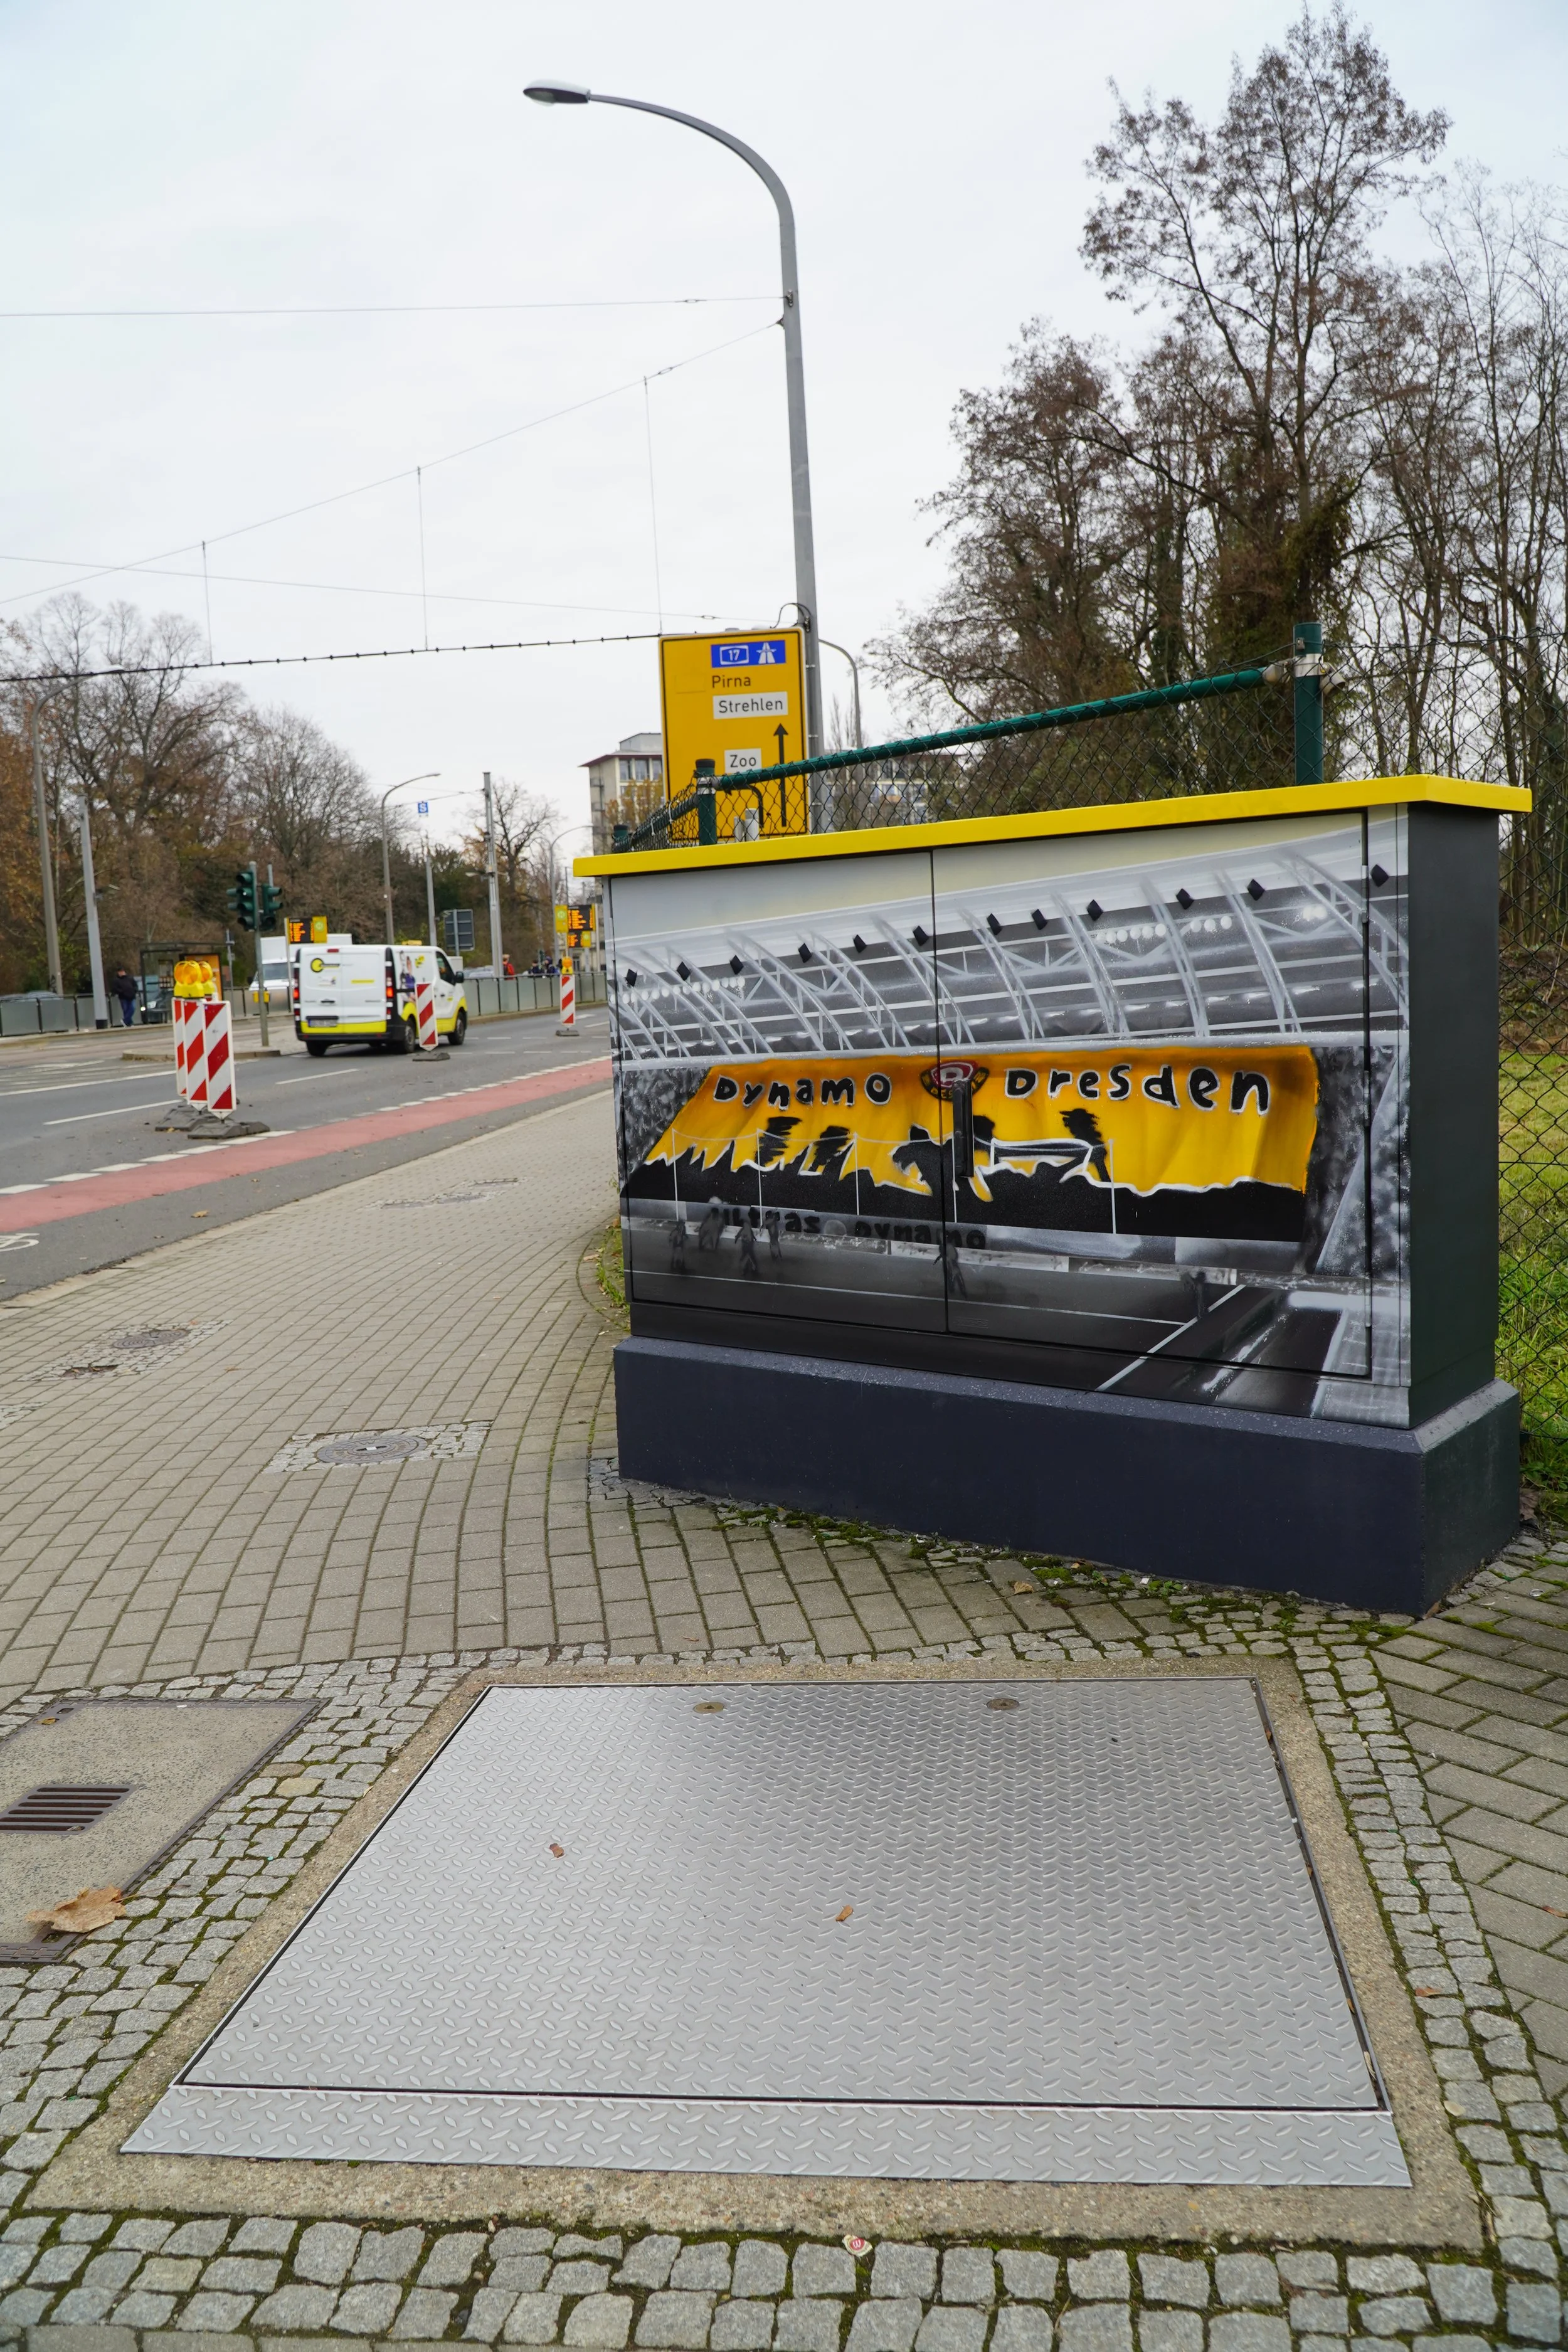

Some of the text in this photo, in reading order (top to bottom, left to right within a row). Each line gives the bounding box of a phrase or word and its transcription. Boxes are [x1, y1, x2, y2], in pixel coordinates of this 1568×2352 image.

[728, 649, 740, 662] 17
[712, 675, 751, 689] Pirna
[719, 698, 783, 714] Strehlen
[729, 755, 757, 768] Zoo
[419, 803, 427, 813] S
[1004, 1062, 1271, 1116] Dresden
